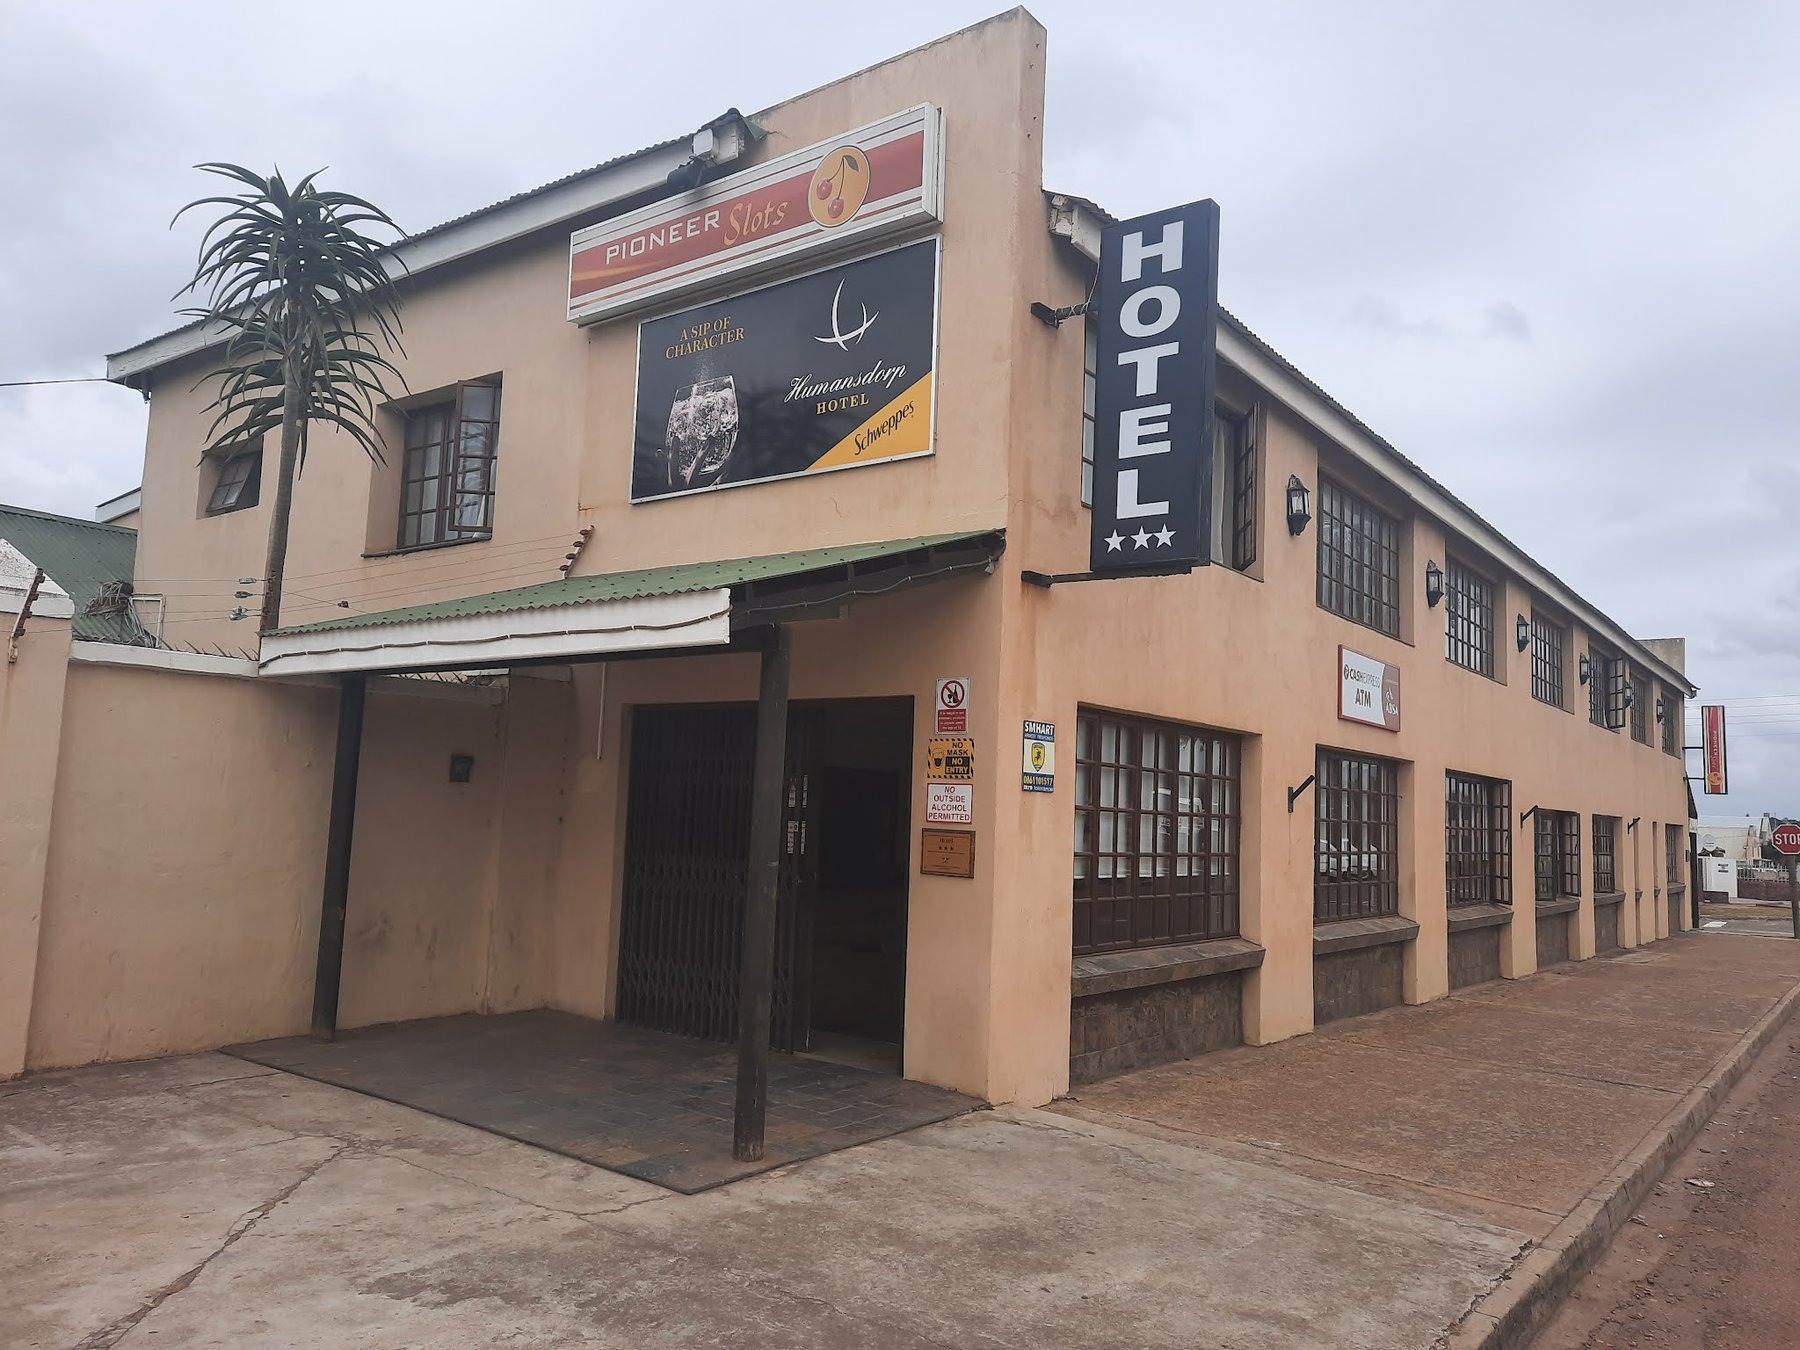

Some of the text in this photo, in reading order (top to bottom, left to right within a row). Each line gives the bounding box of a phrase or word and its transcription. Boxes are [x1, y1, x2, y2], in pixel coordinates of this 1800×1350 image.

[606, 201, 788, 265] PIONEER Slots
[680, 316, 731, 342] A SIP OF
[665, 327, 745, 360] CHARACTER
[1116, 220, 1184, 520] HOTEL
[784, 360, 907, 403] Humansdorp
[816, 393, 870, 415] HOTEL
[854, 400, 915, 456] Schweppes
[1355, 687, 1372, 708] ATM
[1024, 721, 1054, 736] SMHART
[945, 766, 968, 774] ENTRY
[951, 757, 963, 765] NO
[931, 803, 967, 812] ALCOHOL
[933, 794, 966, 803] OUTSIDE
[928, 812, 970, 821] PERMITTED
